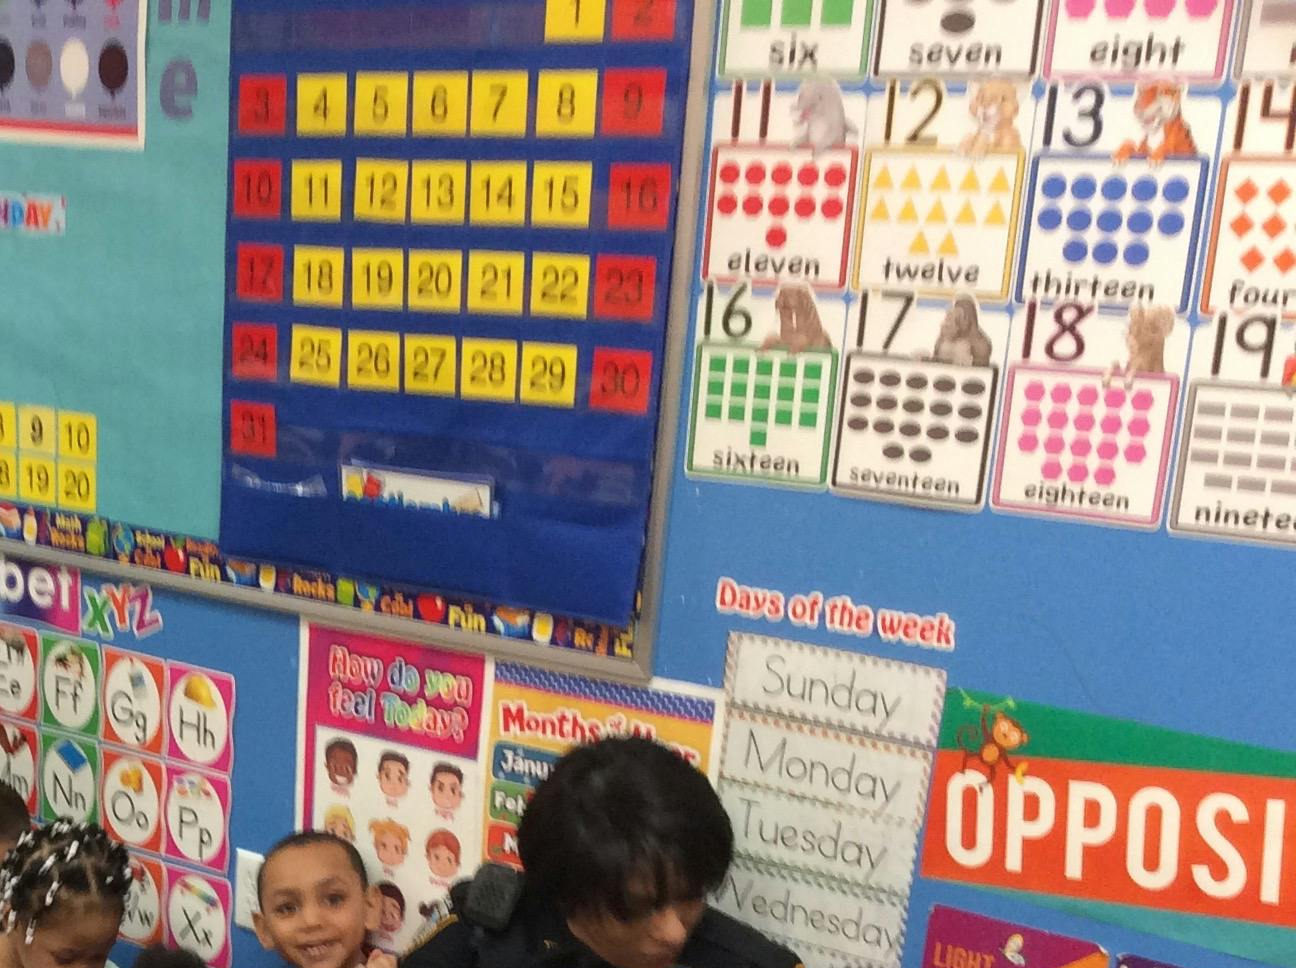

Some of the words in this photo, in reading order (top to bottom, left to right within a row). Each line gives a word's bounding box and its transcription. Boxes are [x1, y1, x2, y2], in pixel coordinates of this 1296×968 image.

[768, 32, 819, 67] six
[908, 42, 1003, 66] seven
[1089, 32, 1185, 68] eight
[312, 86, 330, 126] 4
[372, 84, 389, 125] 5
[431, 84, 448, 123] 6
[488, 83, 509, 124] 7
[556, 82, 576, 122] 8
[730, 79, 773, 146] 11
[884, 77, 944, 146] 12
[1042, 83, 1106, 149] 13
[1233, 81, 1296, 152] 14
[243, 172, 272, 202] 10
[306, 175, 330, 207] 11
[366, 172, 397, 210] 12
[422, 174, 455, 212] 13
[483, 176, 514, 214] 14
[546, 176, 578, 215] 15
[622, 176, 659, 215] 16
[304, 258, 332, 296] 18
[364, 259, 394, 297] 19
[417, 261, 453, 298] 20
[480, 263, 512, 300] 21
[542, 265, 578, 302] 22
[727, 248, 821, 278] eleven
[884, 256, 980, 283] twelve
[1032, 268, 1156, 301] thirteen
[704, 280, 753, 339] 16
[856, 288, 916, 351] 17
[1022, 300, 1094, 363] 18
[298, 336, 331, 372] 25
[357, 342, 391, 377] 26
[413, 346, 446, 382] 27
[470, 350, 506, 385] 28
[530, 355, 566, 392] 29
[601, 359, 640, 397] 30
[1211, 312, 1277, 379] 19
[31, 414, 43, 444] 9
[67, 420, 89, 453] 10
[242, 413, 267, 444] 31
[712, 445, 800, 475] sixteen
[848, 465, 961, 495] seventeen
[26, 464, 49, 495] 19
[64, 470, 89, 502] 20
[1022, 481, 1131, 511] eighteen
[1195, 499, 1296, 529] ninete
[83, 583, 163, 638] XYZ
[718, 580, 781, 619] Days
[790, 593, 821, 626] of
[825, 598, 872, 634] the
[880, 610, 954, 649] week
[55, 674, 83, 715] Ff
[329, 644, 384, 689] How
[387, 656, 420, 696] do
[424, 668, 473, 708] you
[762, 653, 903, 733] Sunday
[111, 690, 147, 745] Gg
[179, 704, 215, 750] Hh
[328, 680, 377, 724] feel
[380, 691, 469, 744] Today?
[500, 700, 602, 744] Months
[54, 770, 87, 813] Nn
[744, 727, 902, 814] Monday
[111, 790, 149, 830] Oo
[179, 806, 213, 863] Pp
[740, 797, 888, 883] Tuesday
[945, 768, 1287, 907] OPPOSI
[179, 906, 214, 949] Xx
